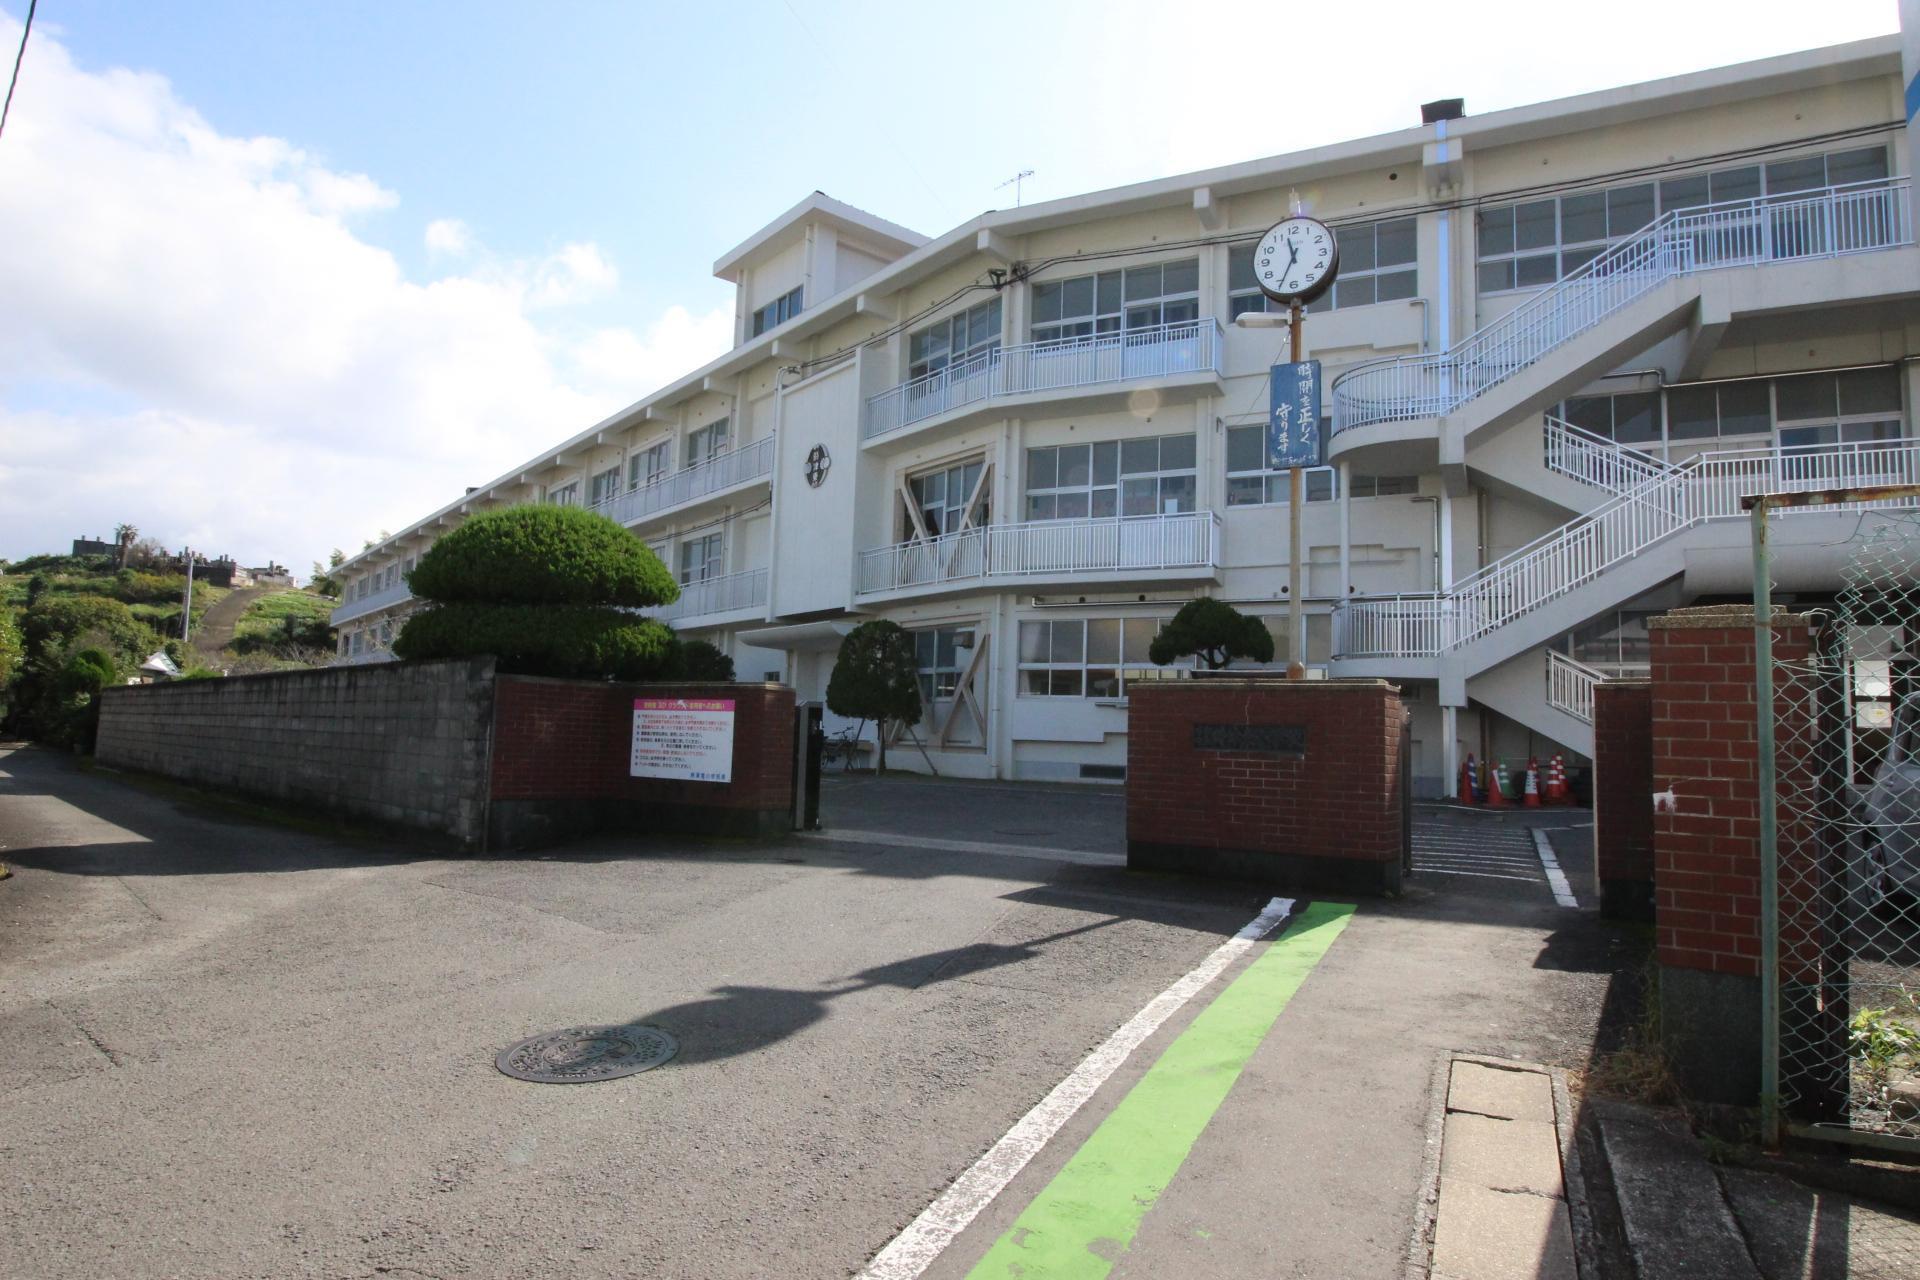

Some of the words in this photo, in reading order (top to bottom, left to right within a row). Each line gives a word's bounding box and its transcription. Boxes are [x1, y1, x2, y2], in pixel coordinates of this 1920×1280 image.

[1288, 226, 1299, 235] 12
[1273, 234, 1284, 243] 11
[1314, 235, 1323, 244] 2
[1263, 246, 1275, 255] 10
[1318, 248, 1328, 256] 3
[1261, 258, 1270, 267] 9
[1314, 261, 1324, 269] 4
[1264, 271, 1274, 279] 8
[1305, 273, 1315, 282] 5
[1289, 280, 1299, 289] 6
[1297, 362, 1315, 444] 時間を正しく
[1275, 402, 1293, 454] 守ります
